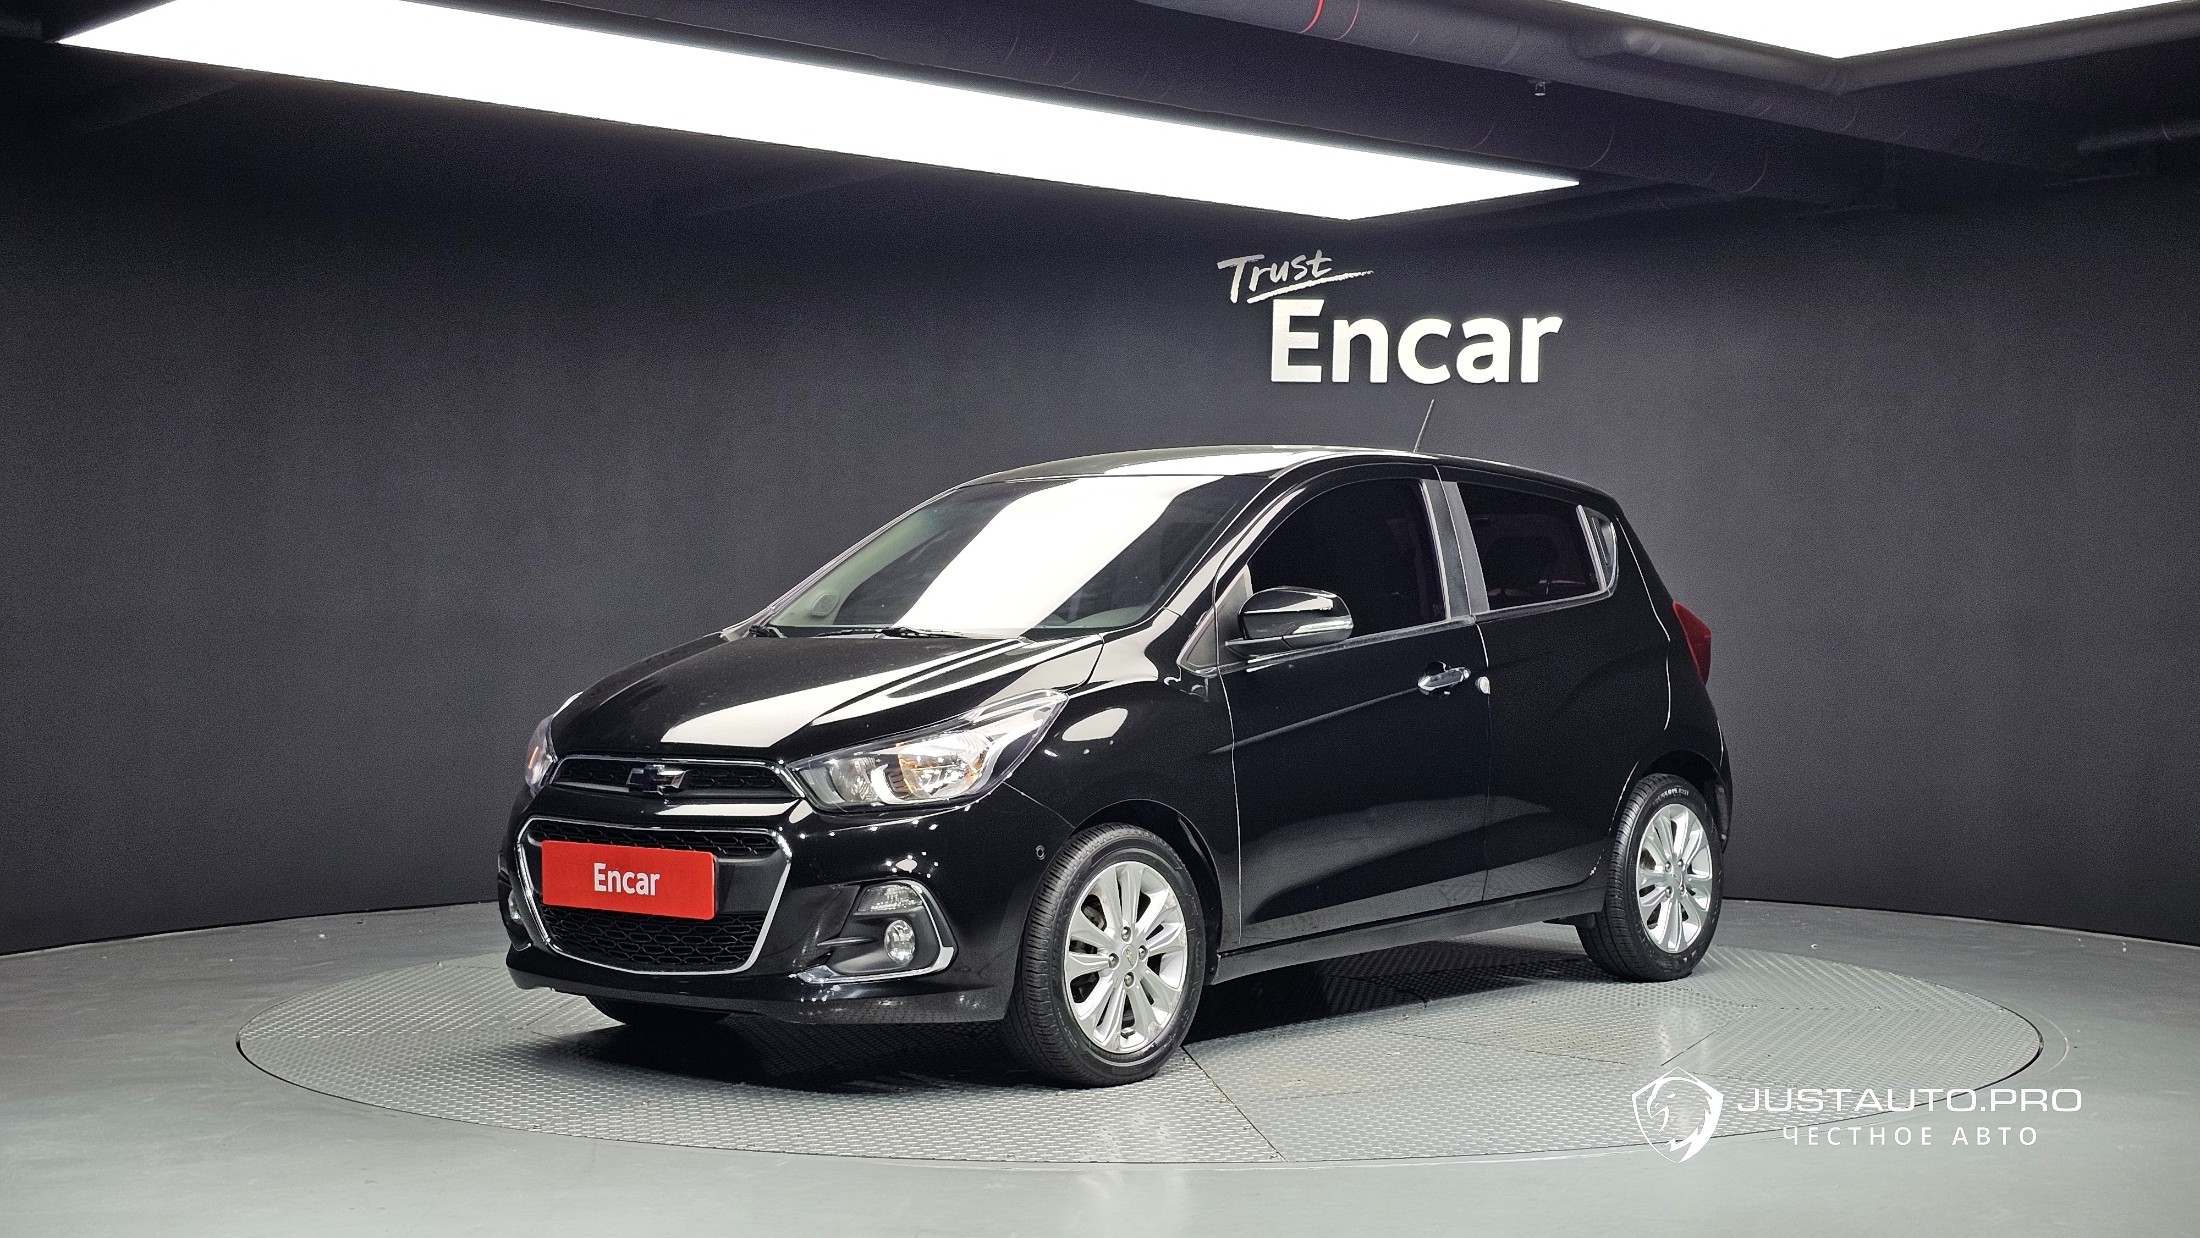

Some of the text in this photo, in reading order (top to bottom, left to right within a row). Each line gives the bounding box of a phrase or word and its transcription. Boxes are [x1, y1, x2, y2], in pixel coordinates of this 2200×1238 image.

[1217, 250, 1333, 303] Trust
[1270, 299, 1564, 385] Encar
[593, 862, 660, 897] Encar
